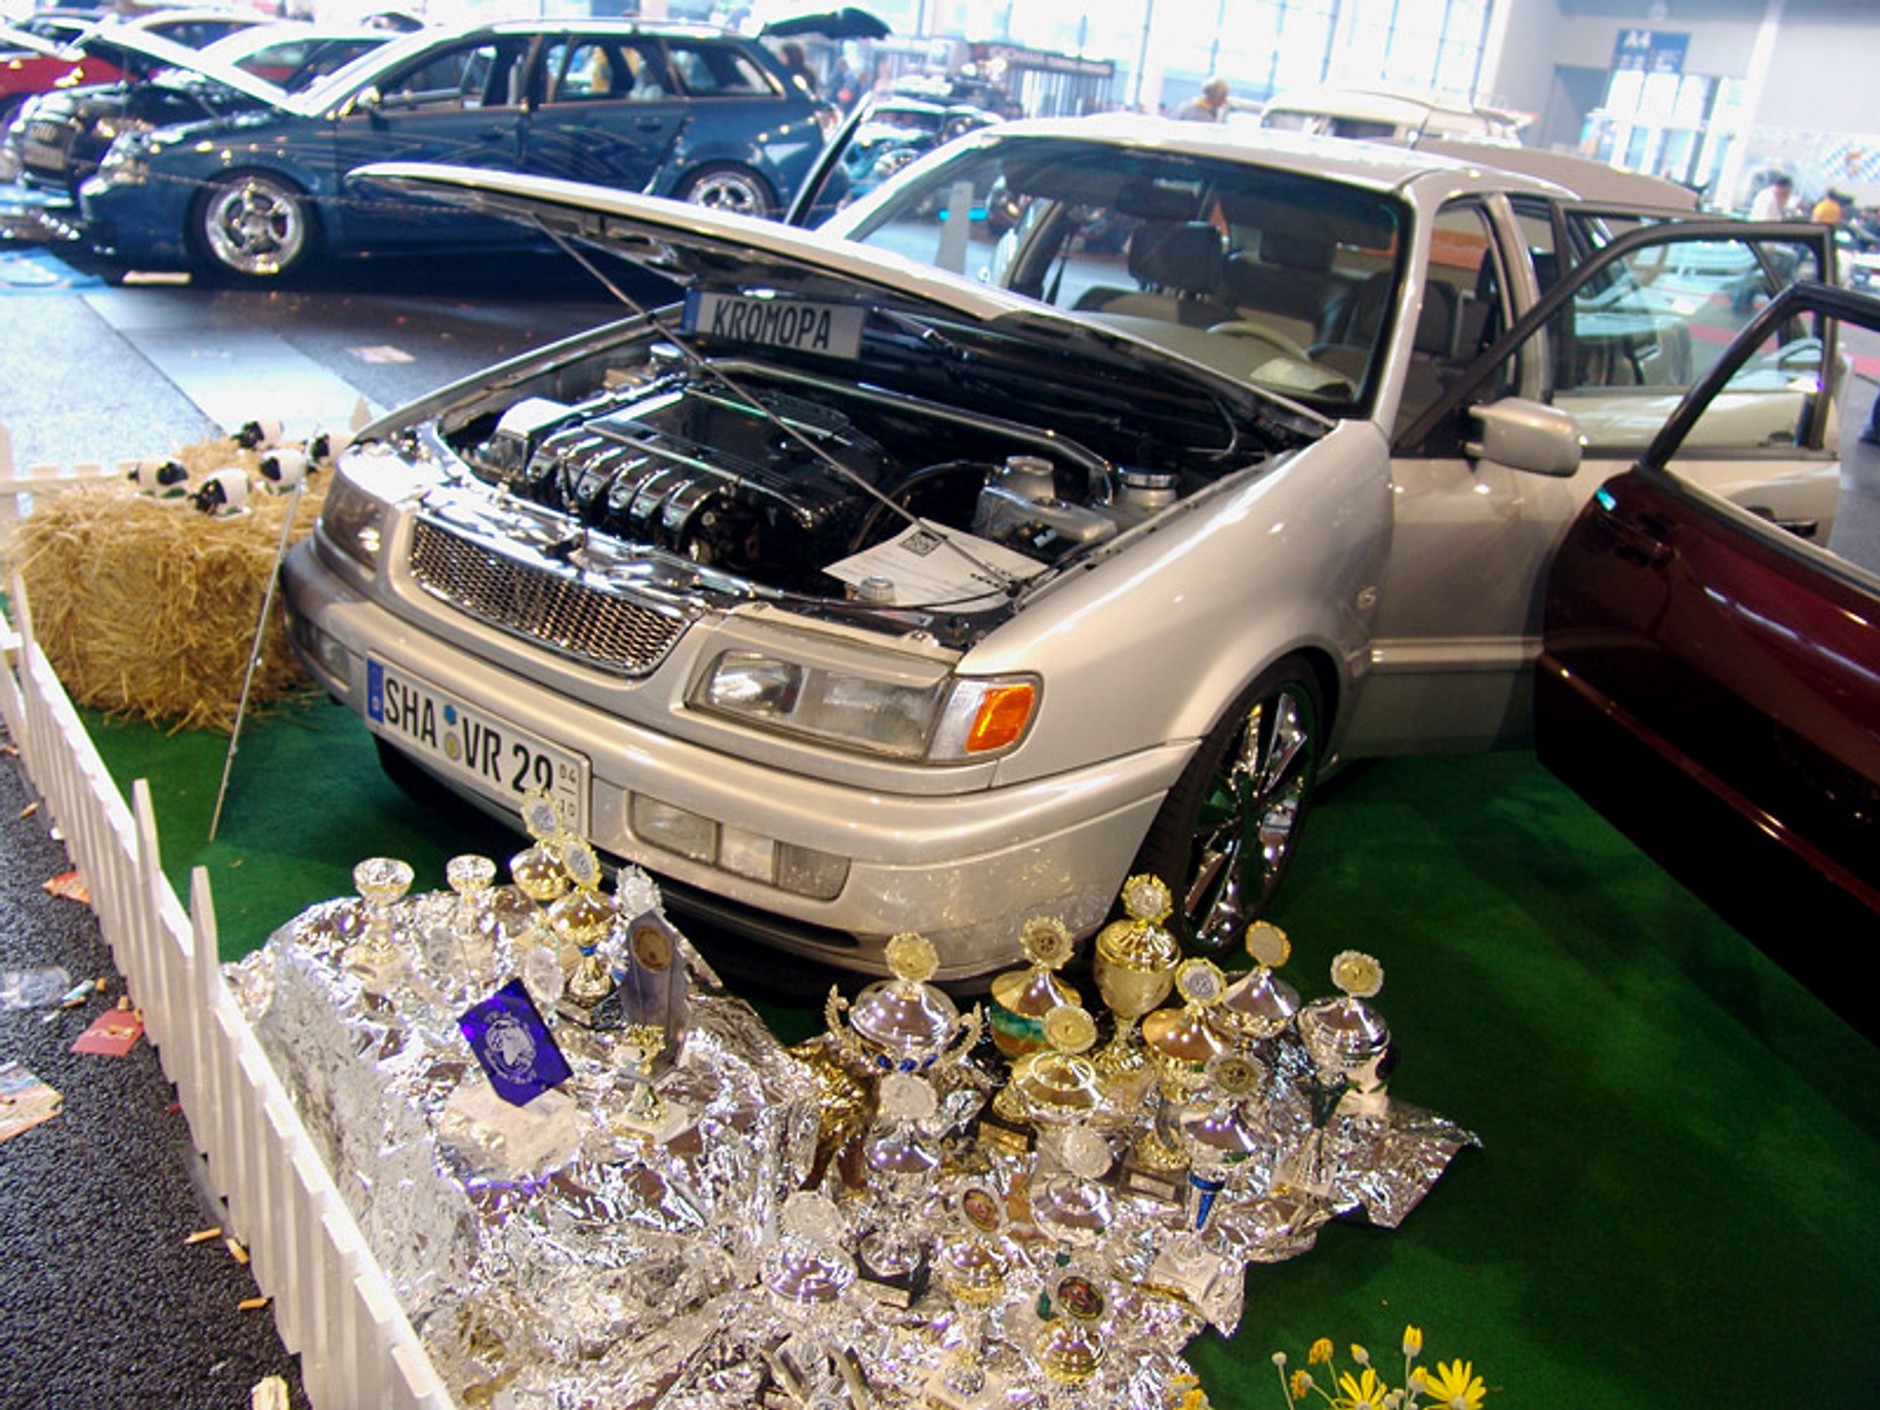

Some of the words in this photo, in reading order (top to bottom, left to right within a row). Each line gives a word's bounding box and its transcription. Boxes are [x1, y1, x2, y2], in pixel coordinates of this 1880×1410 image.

[1624, 30, 1651, 48] A4
[711, 298, 832, 350] KROMOPA
[385, 677, 438, 749] SHA
[463, 716, 502, 783] VR
[512, 743, 553, 797] 29
